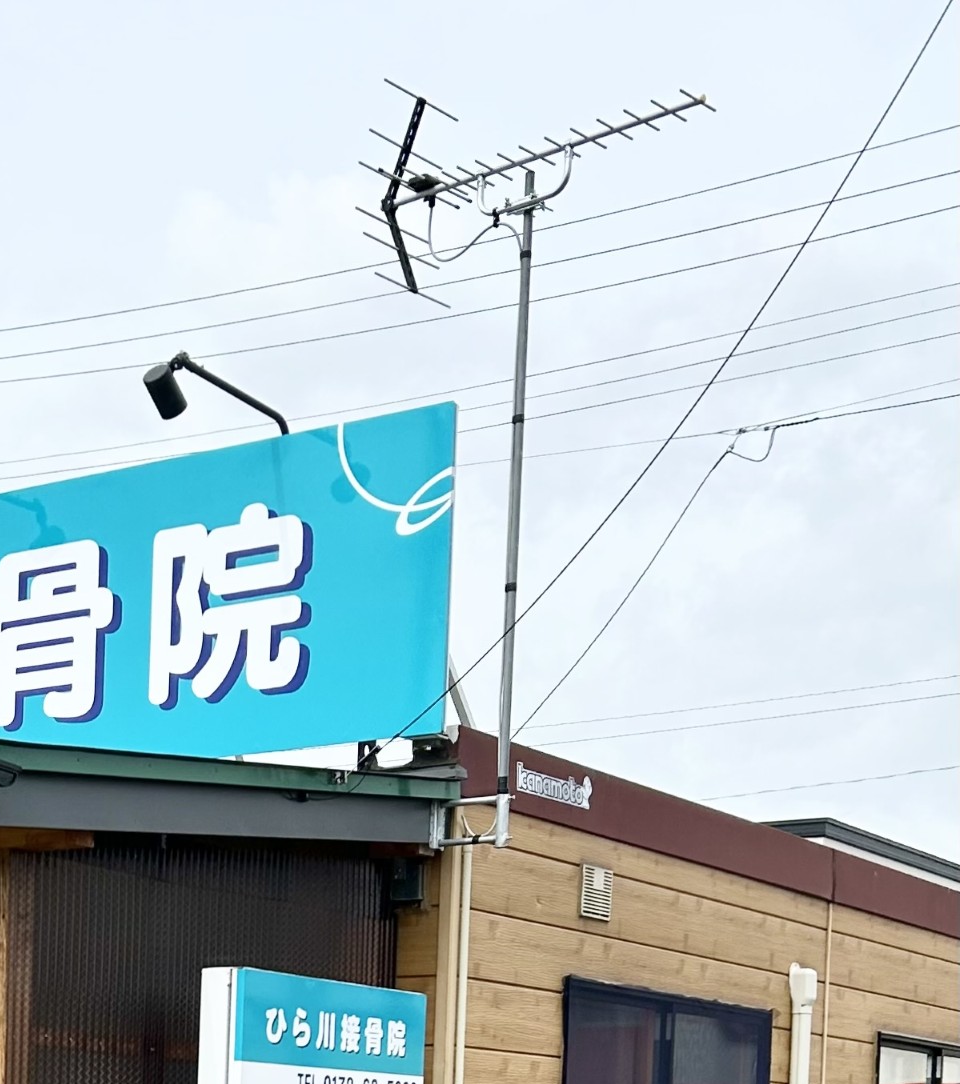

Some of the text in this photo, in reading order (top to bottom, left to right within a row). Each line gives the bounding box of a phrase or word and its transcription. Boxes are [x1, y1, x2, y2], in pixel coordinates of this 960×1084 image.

[265, 1007, 407, 1058] ひら川接骨院
